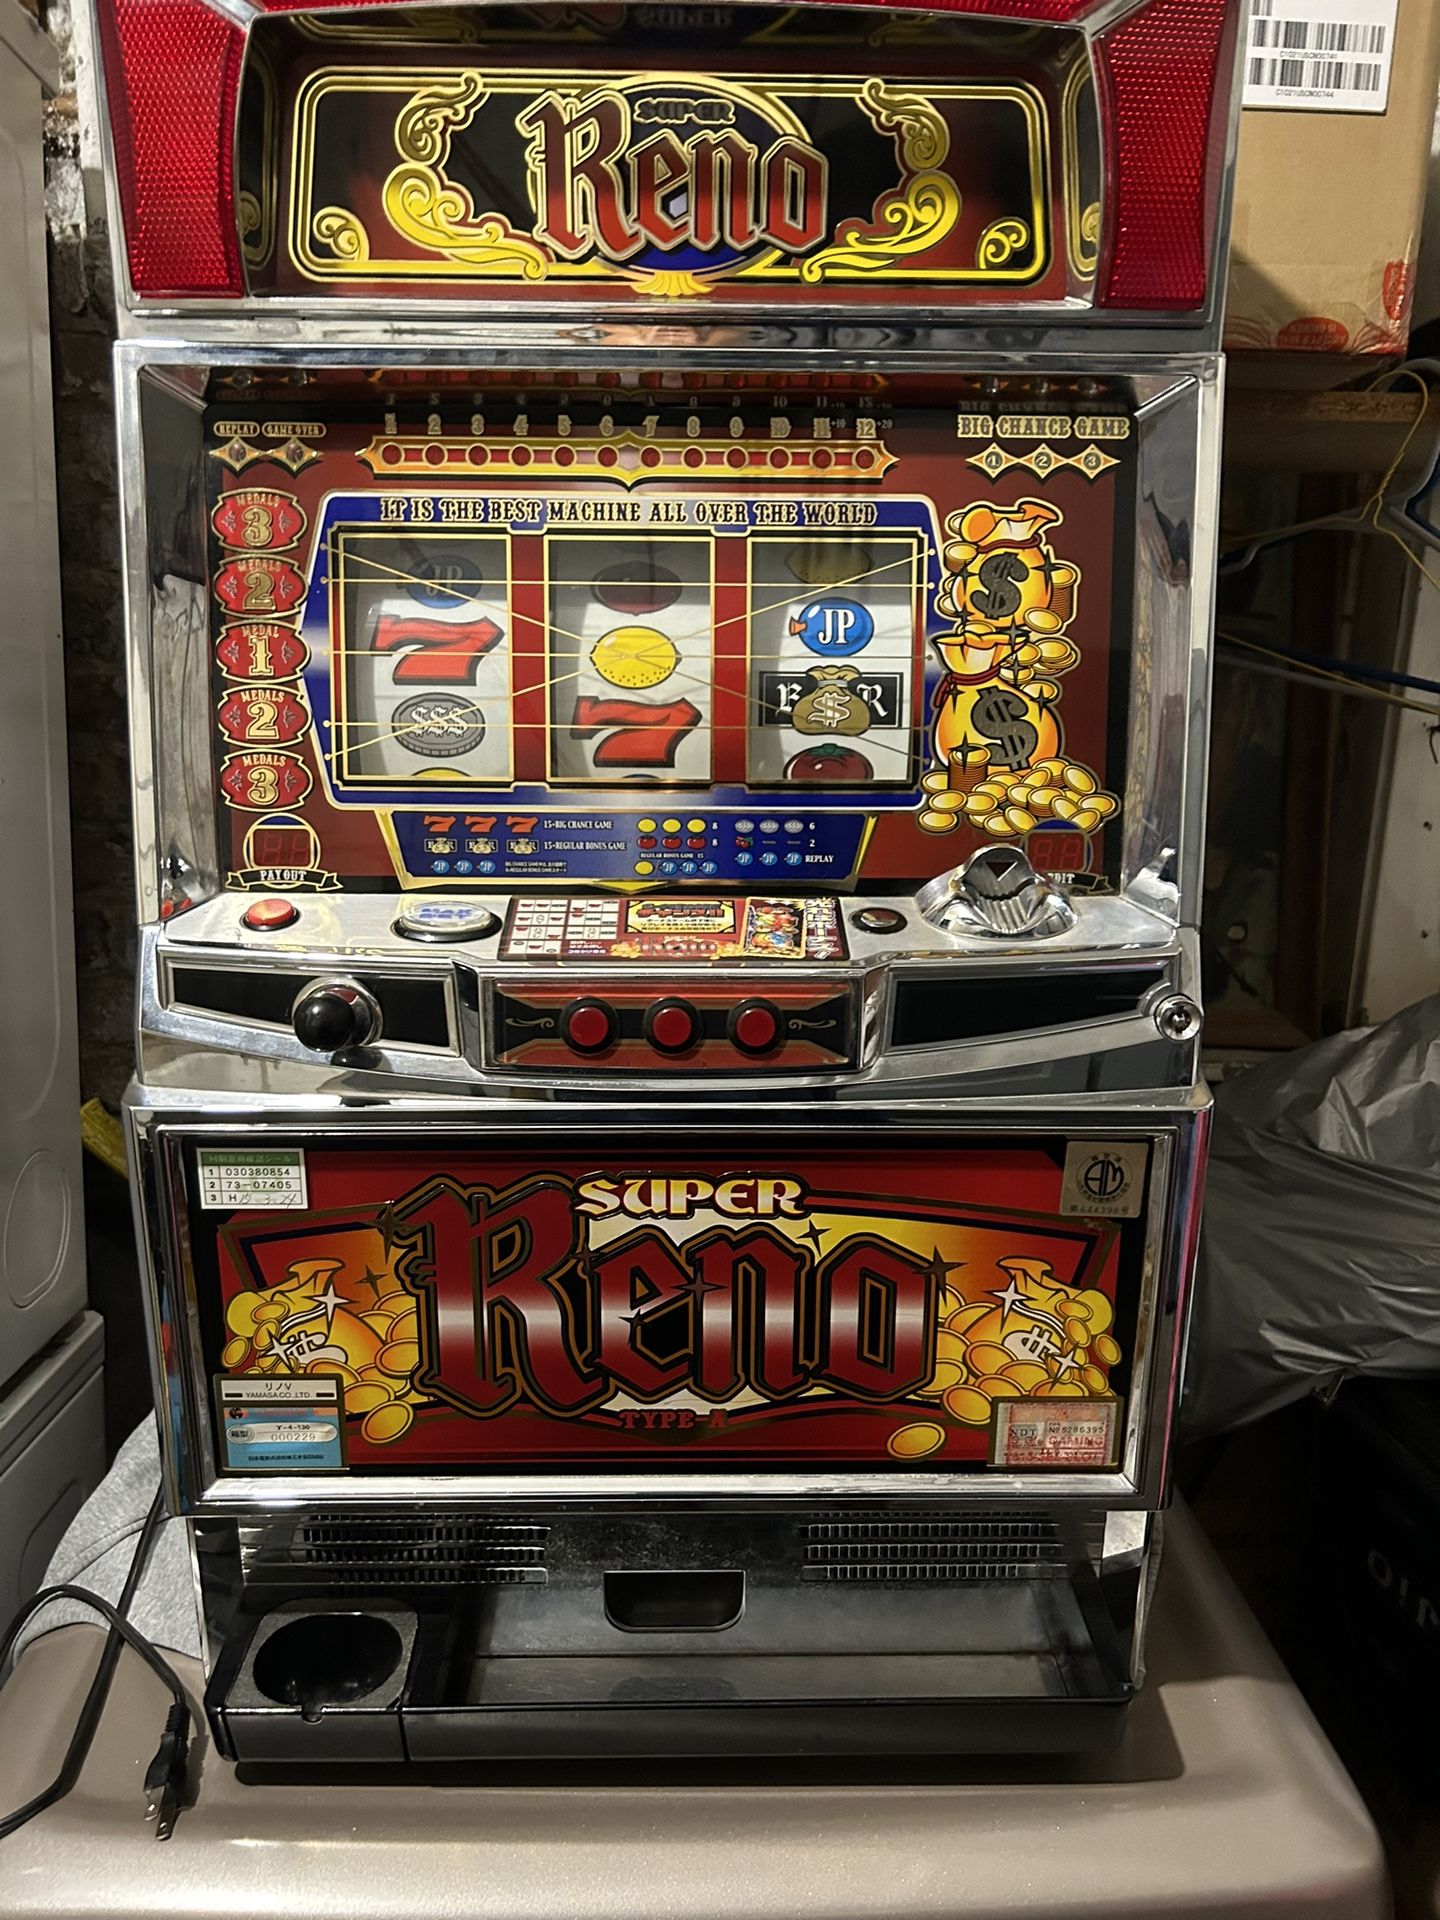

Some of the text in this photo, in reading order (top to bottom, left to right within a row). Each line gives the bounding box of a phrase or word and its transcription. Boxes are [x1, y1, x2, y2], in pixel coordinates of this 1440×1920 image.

[634, 99, 735, 124] SUPER
[515, 89, 829, 260] Reno
[220, 424, 255, 434] REPLAY
[267, 425, 319, 436] GAME OVER
[384, 413, 397, 434] 1
[427, 413, 442, 435] 2
[471, 413, 485, 435] 3
[513, 413, 528, 435] 4
[557, 414, 572, 436] 5
[600, 415, 614, 437] 6
[643, 415, 660, 437] 7
[686, 415, 701, 437] 8
[730, 416, 744, 438] 9
[770, 416, 791, 438] 10
[831, 417, 846, 428] +10
[856, 417, 876, 438] 12
[877, 418, 893, 429] +20
[957, 414, 1130, 440] BIG CHANCE GAME
[235, 493, 281, 507] MEDALS
[381, 498, 878, 526] IT IS THE BEST MACHINE ALL OVER THE WORLD
[241, 505, 272, 547] 3
[237, 559, 282, 572] MEDALS
[423, 563, 464, 595] JP
[243, 570, 276, 611] 2
[241, 625, 279, 638] MEDAL
[817, 607, 855, 645] JP
[248, 635, 275, 676] 1
[369, 614, 505, 686] 7
[240, 689, 285, 703] MEDALS
[246, 700, 280, 739] 2
[570, 695, 703, 768] 7
[242, 753, 287, 767] MEDALS
[247, 765, 279, 806] 3
[568, 820, 593, 829] CHANCE
[594, 820, 613, 829] GAME
[711, 821, 718, 830] 8
[808, 821, 816, 830] 6
[585, 842, 607, 850] BONUS
[608, 842, 627, 850] GAME
[711, 838, 718, 847] 8
[808, 839, 816, 847] 2
[805, 855, 835, 863] REPLAY
[208, 1168, 291, 1176] 1 030380854
[209, 1181, 216, 1189] 2
[210, 1194, 237, 1202] 3 H
[574, 1176, 808, 1218] SUPER
[392, 1173, 936, 1416] Reno
[618, 1410, 728, 1430] TYPE-A
